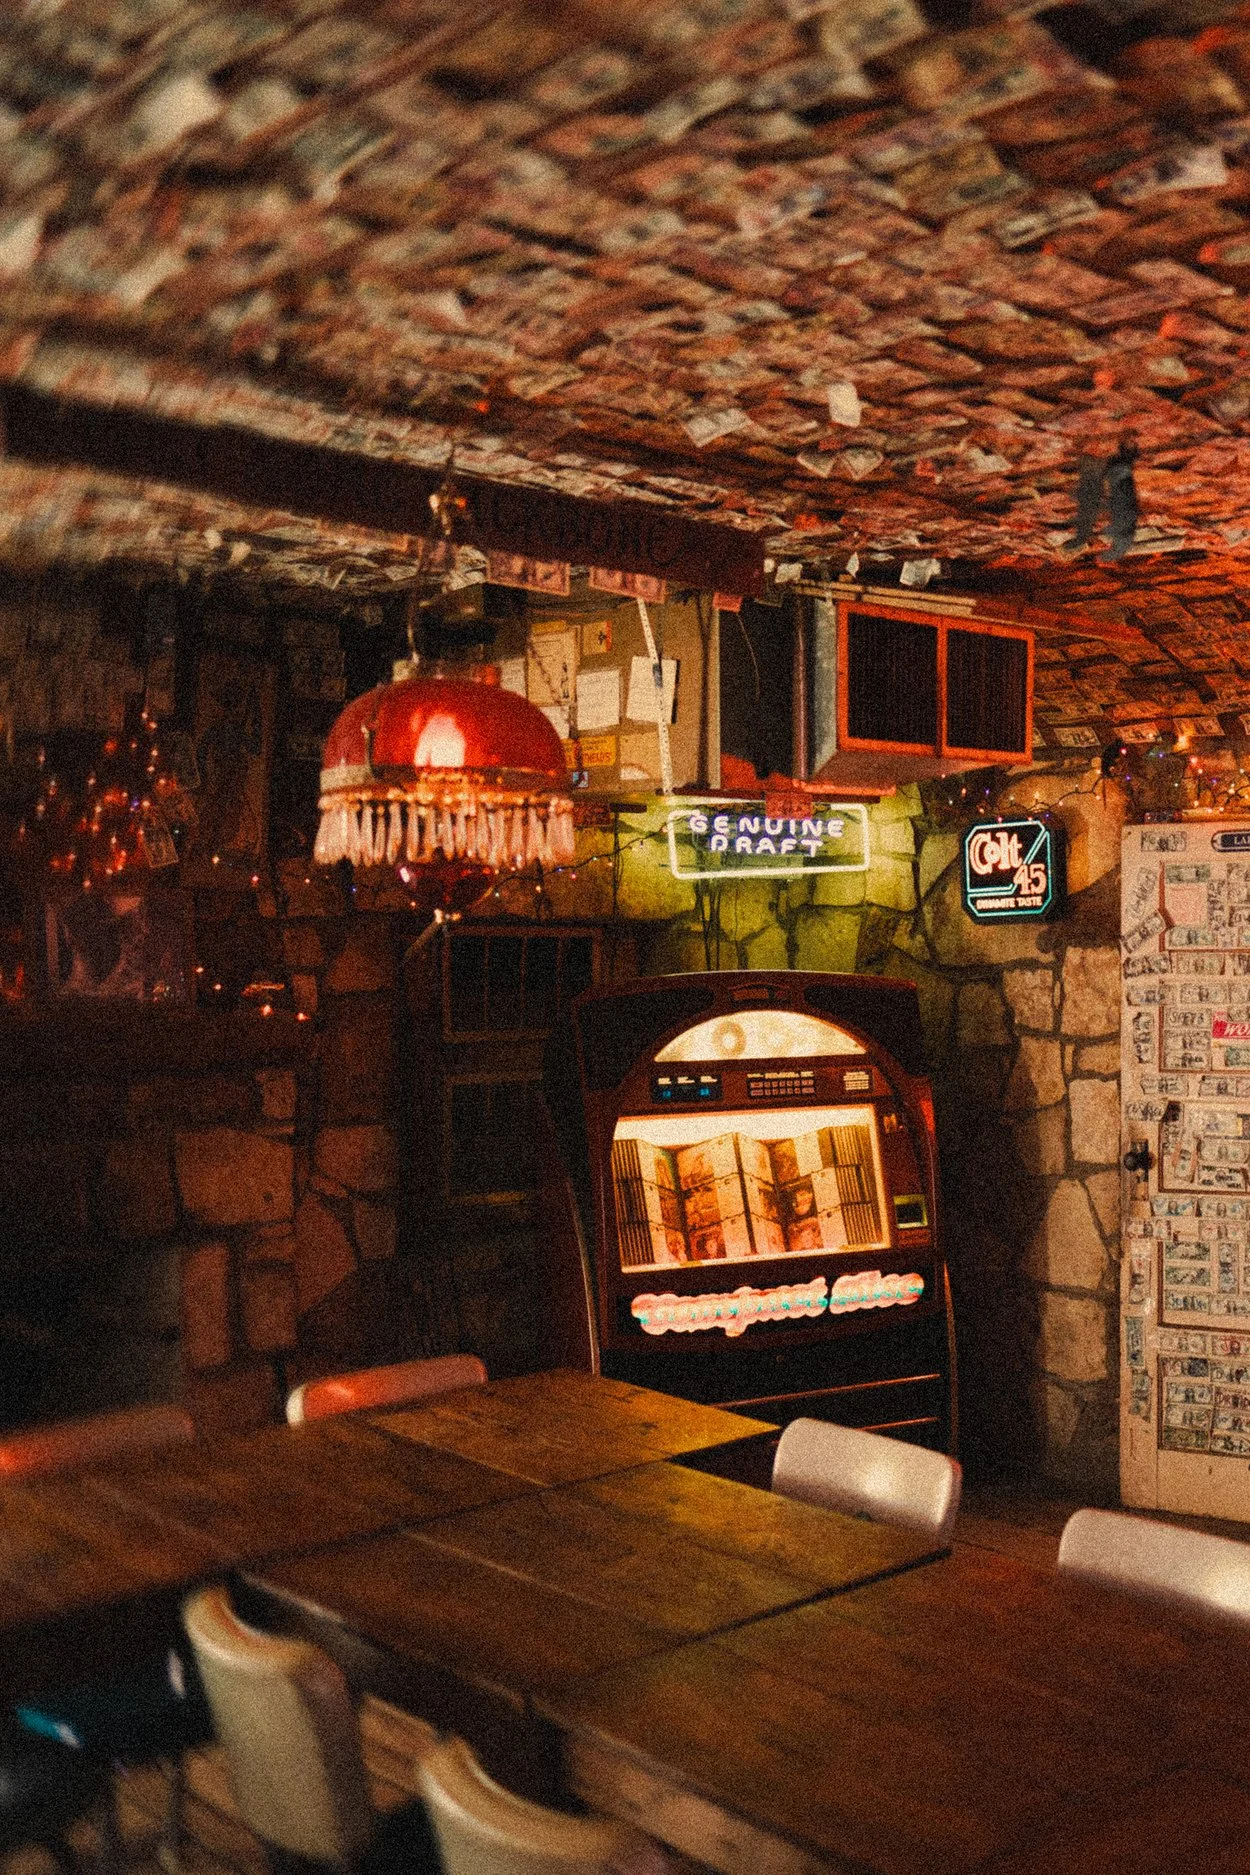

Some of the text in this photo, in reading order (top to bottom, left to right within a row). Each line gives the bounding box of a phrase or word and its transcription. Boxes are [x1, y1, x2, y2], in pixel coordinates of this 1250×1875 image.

[689, 815, 845, 838] GENUINE
[711, 834, 824, 858] DRAFT
[969, 832, 1023, 875] Colt
[1013, 864, 1047, 895] 45
